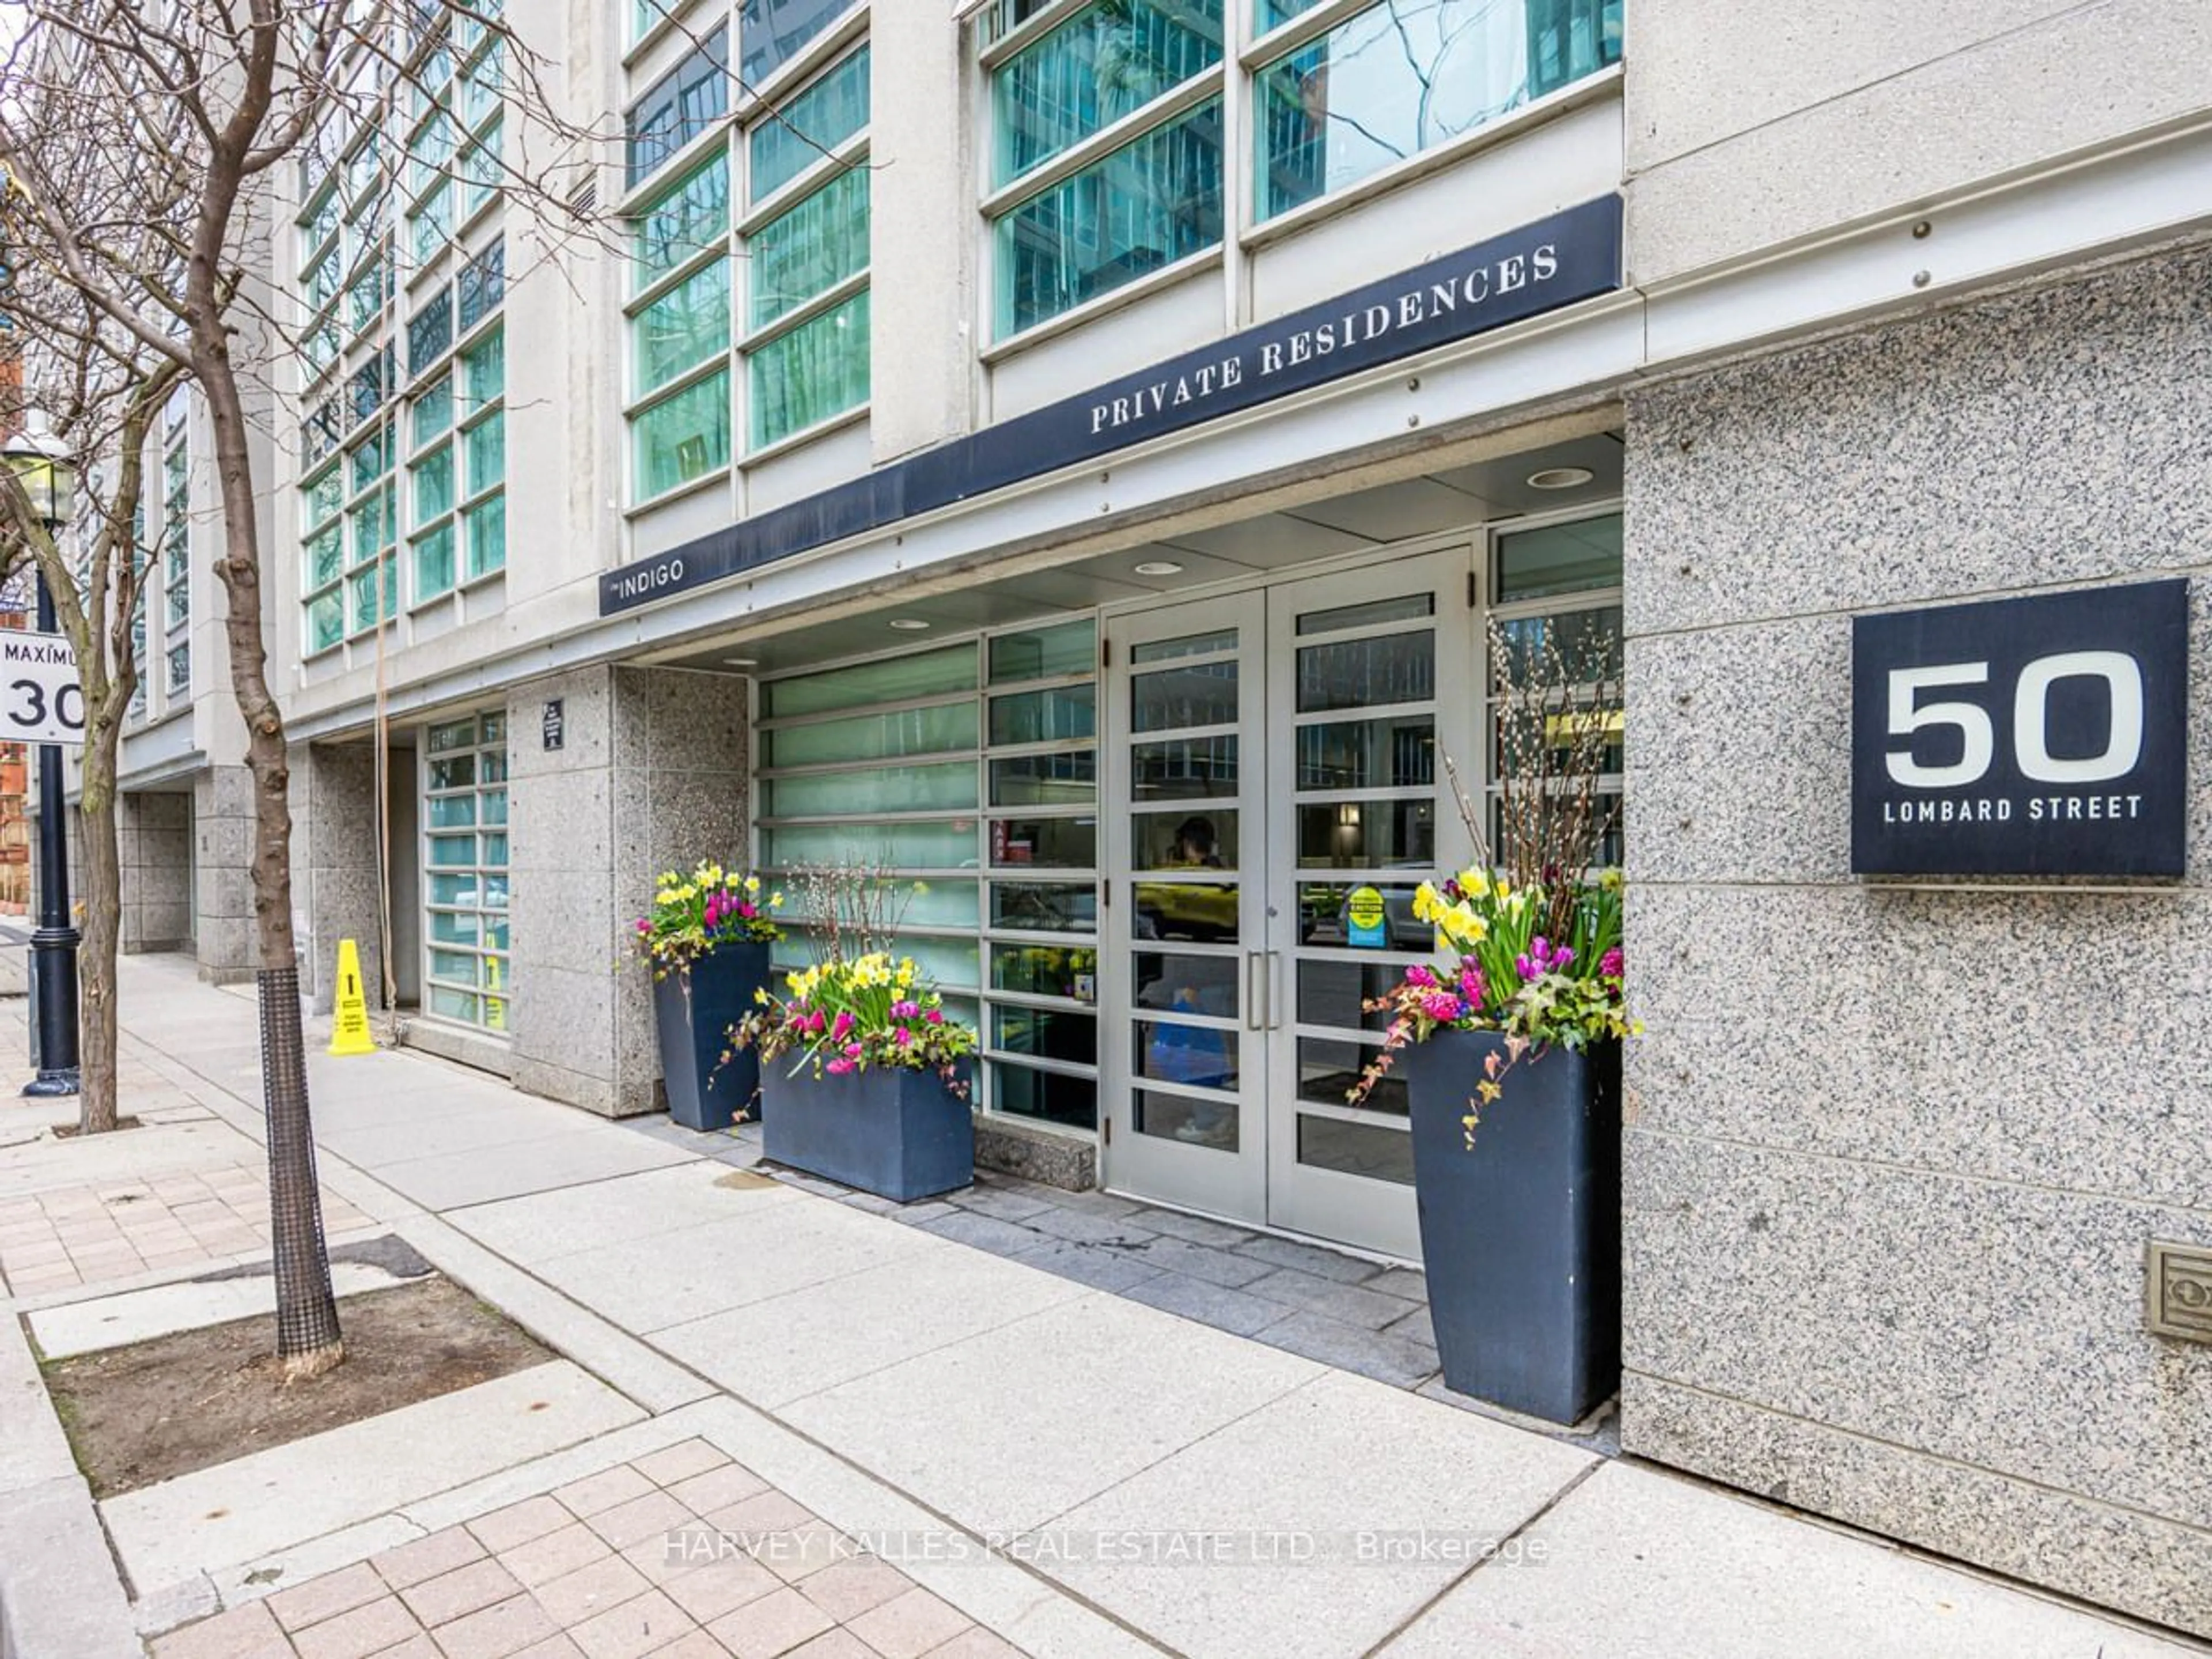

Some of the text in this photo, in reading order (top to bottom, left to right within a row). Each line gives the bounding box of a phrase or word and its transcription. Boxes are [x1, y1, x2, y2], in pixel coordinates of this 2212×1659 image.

[1090, 245, 1559, 434] PRIVATE RESIDENCES
[619, 560, 683, 599] INDIGO
[5, 643, 77, 666] MAXIMU
[9, 679, 86, 730] 30
[1885, 650, 2143, 787] 50
[1884, 796, 2142, 823] LOMBARD STREET
